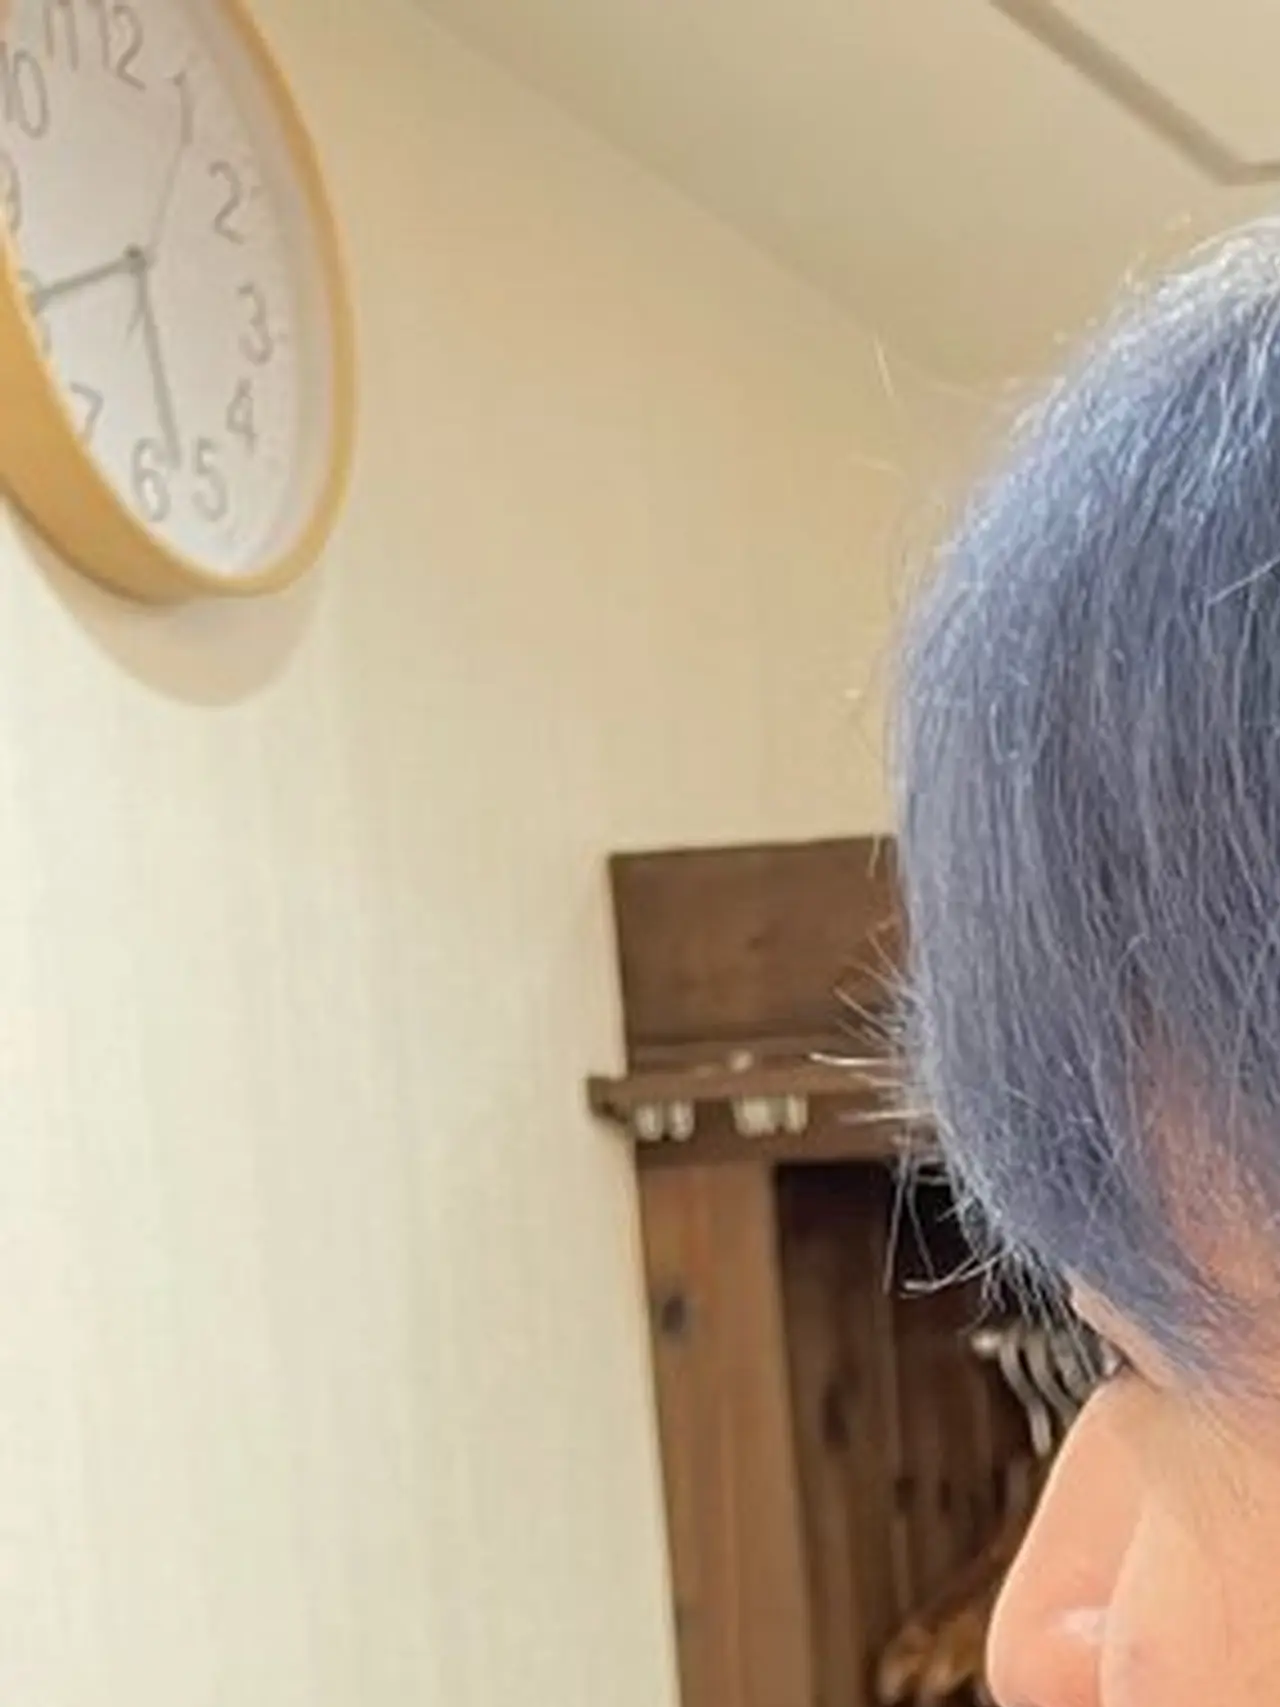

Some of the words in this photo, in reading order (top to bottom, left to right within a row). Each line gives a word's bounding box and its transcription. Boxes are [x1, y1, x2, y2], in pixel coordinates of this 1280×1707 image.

[88, 0, 146, 90] 12
[208, 160, 244, 245] 2
[239, 282, 274, 365] 3
[226, 378, 257, 454] 4
[131, 436, 170, 522] 6
[191, 437, 229, 522] 5
